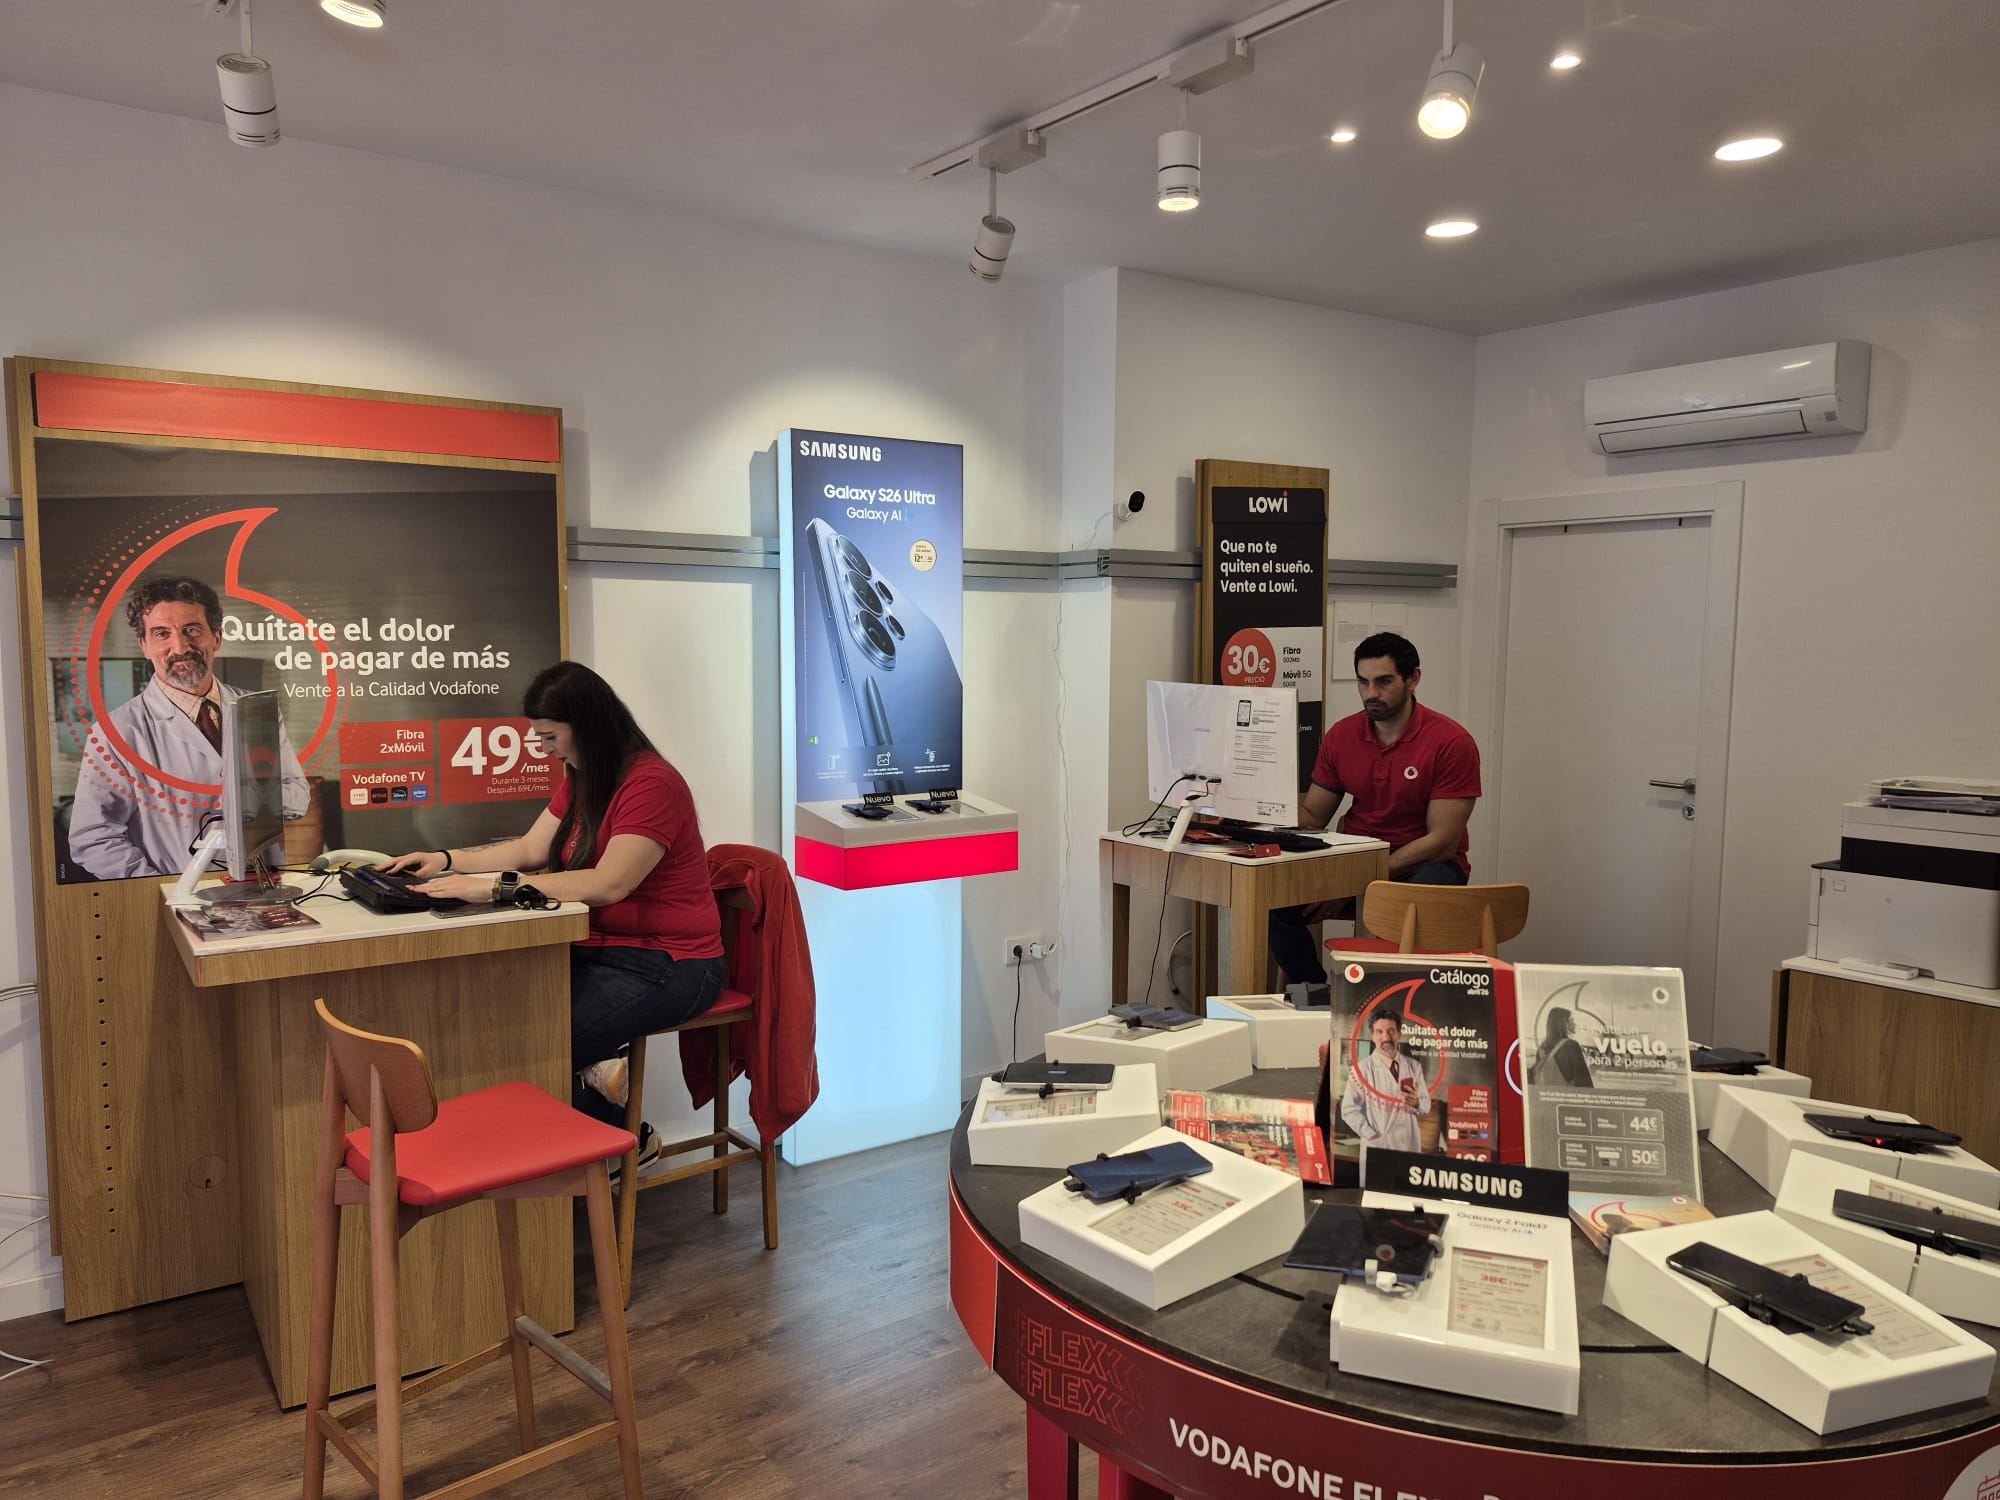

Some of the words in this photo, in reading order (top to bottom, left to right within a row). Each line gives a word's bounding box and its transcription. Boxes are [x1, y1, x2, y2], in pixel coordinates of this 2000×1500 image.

[800, 440, 882, 462] SAMSUNG
[824, 484, 876, 504] Galaxy
[878, 488, 902, 503] S26
[904, 489, 936, 505] Ultra
[846, 507, 888, 524] Galaxy
[1220, 539, 1246, 554] Que
[1248, 542, 1263, 553] no
[1265, 541, 1277, 553] te
[1220, 559, 1260, 577] quiten
[1262, 560, 1273, 573] el
[1275, 560, 1313, 573] sueño.
[1220, 580, 1256, 593] Vente
[1258, 582, 1267, 593] a
[1269, 579, 1298, 593] Lowi.
[221, 614, 336, 642] Quítate
[343, 617, 373, 642] el
[379, 618, 455, 642] dolor
[1283, 647, 1301, 655] Fibra
[274, 646, 312, 670] de
[320, 650, 404, 676] pagar
[411, 646, 446, 669] de
[453, 644, 510, 669] más
[1228, 645, 1270, 675] 30€
[1283, 670, 1301, 679] Móvil
[1302, 670, 1312, 678] 5G
[284, 683, 332, 698] Vente
[337, 686, 345, 697] a
[350, 683, 364, 697] la
[368, 682, 426, 697] Calidad
[429, 680, 500, 697] Vodafone
[397, 729, 425, 740] Fibra
[380, 742, 425, 755] 2xMóvil
[520, 762, 550, 773] /mes
[352, 773, 408, 785] Vodafone
[409, 771, 426, 782] TV
[491, 776, 520, 785] Durante
[487, 784, 517, 794] Después
[931, 790, 956, 798] Nuevo
[866, 796, 891, 804] Nuevo
[1430, 968, 1489, 989] Catálogo
[1401, 1023, 1437, 1036] Quítate
[1439, 1026, 1449, 1037] el
[1450, 1026, 1476, 1037] dolor
[1409, 1036, 1422, 1047] de
[1423, 1038, 1451, 1049] pagar
[1453, 1038, 1465, 1049] de
[1467, 1038, 1488, 1049] más
[1593, 1035, 1667, 1056] vuelo
[1588, 1056, 1612, 1067] para
[1615, 1055, 1622, 1066] 2
[1624, 1056, 1677, 1070] personas
[1630, 1116, 1657, 1131] 44€
[1632, 1149, 1659, 1165] 50€
[1409, 1166, 1523, 1199] SAMSUNG
[1457, 1212, 1501, 1225] Galaxy
[1514, 1219, 1548, 1230] Fold7
[1169, 1417, 1344, 1500] VODAFONE
